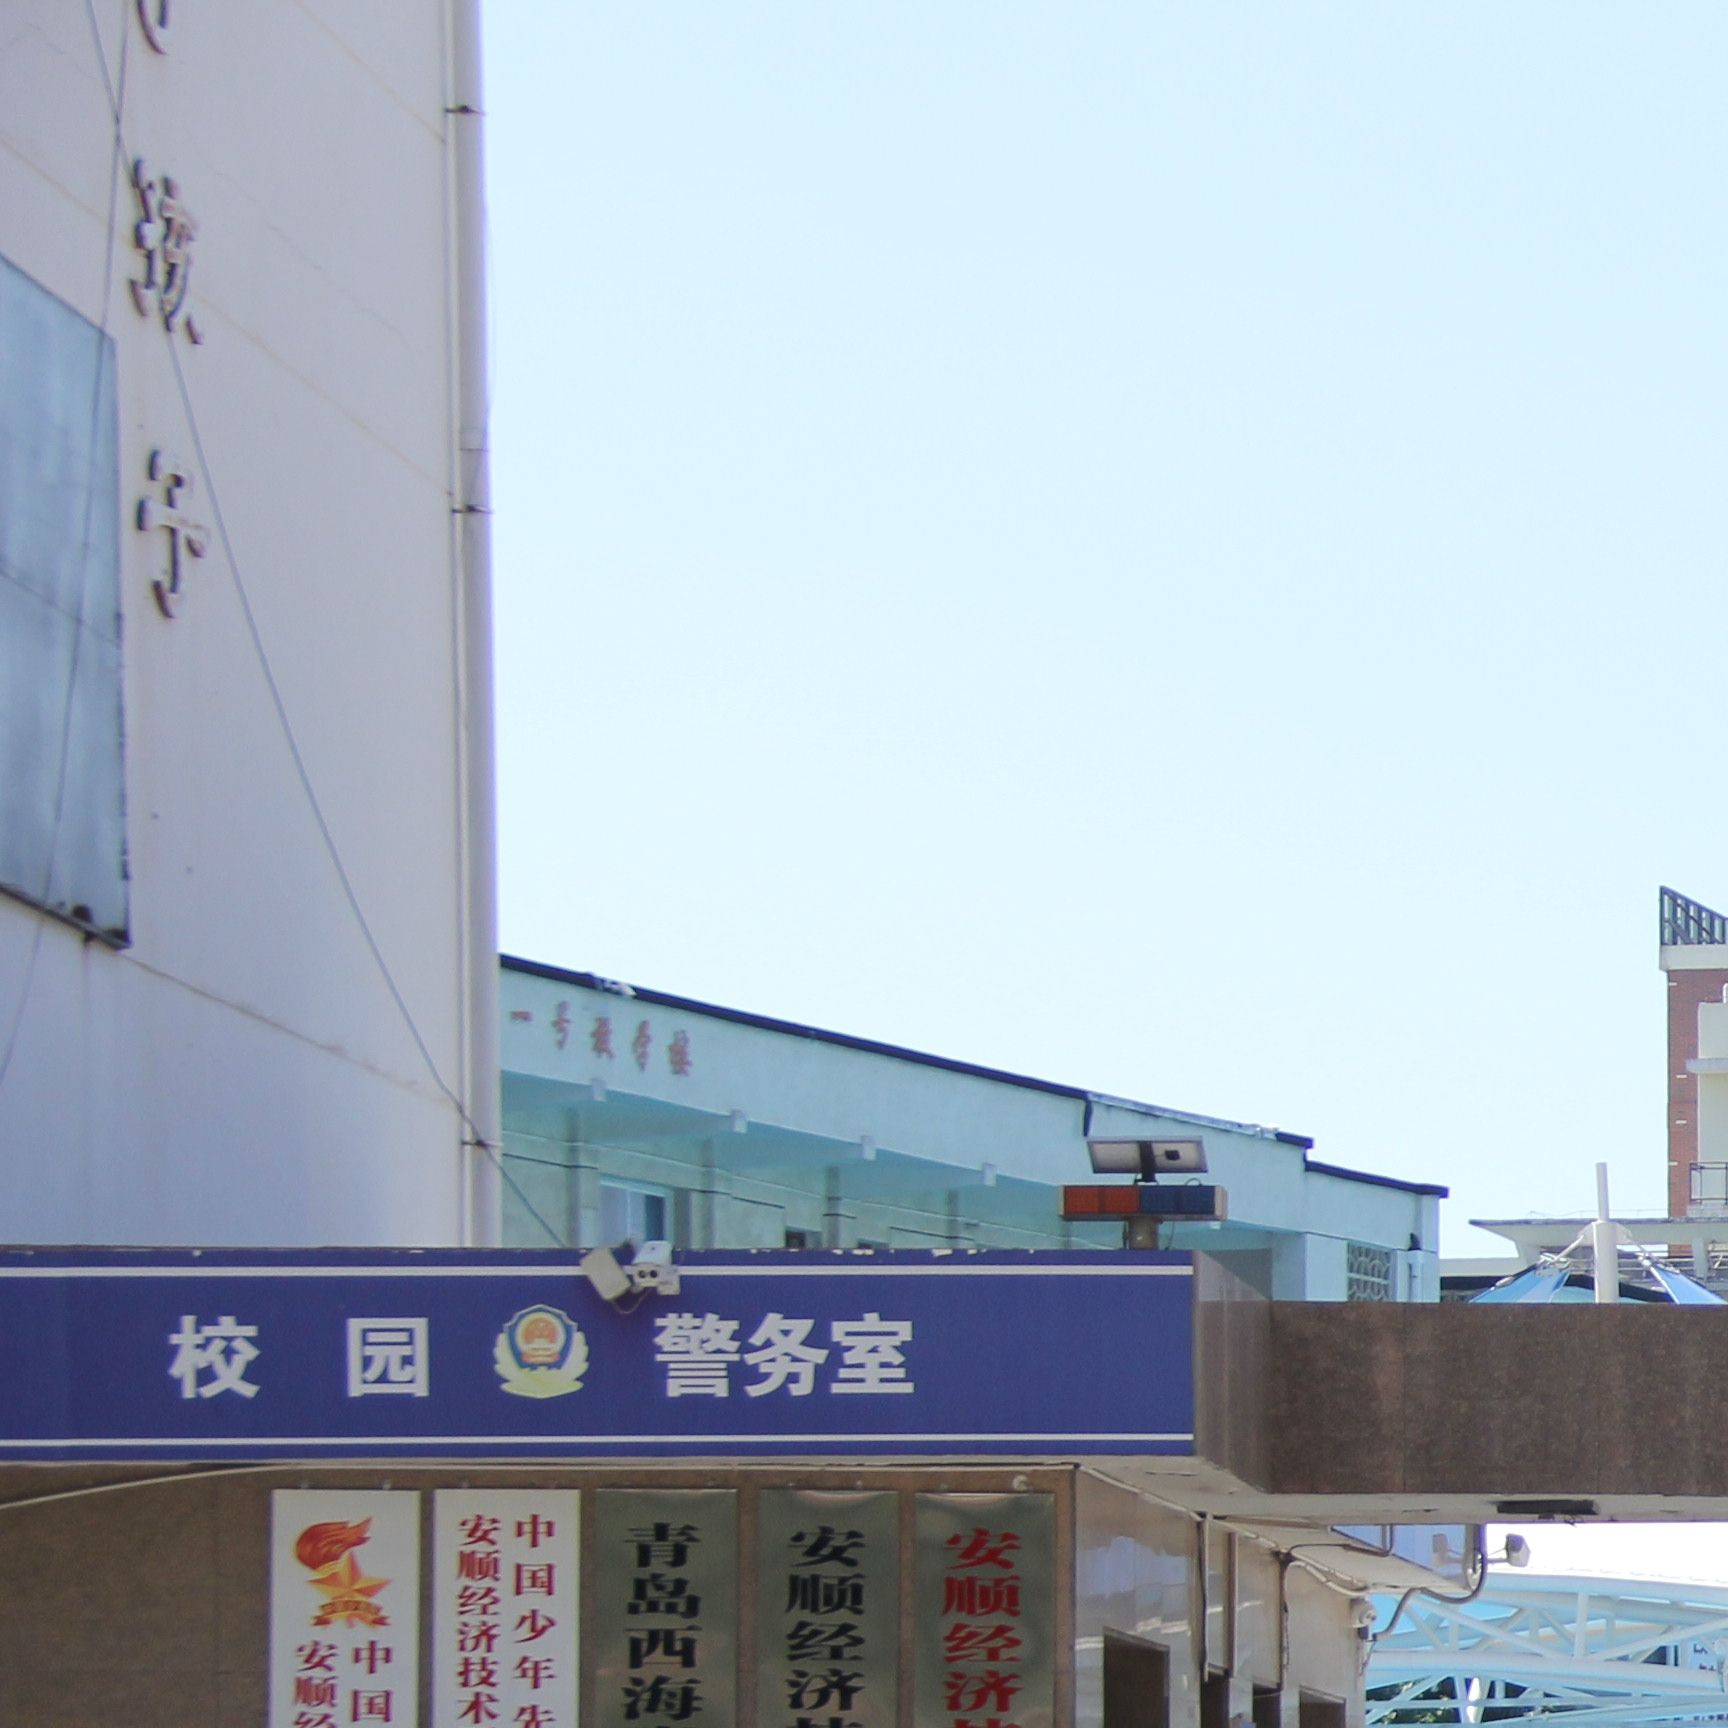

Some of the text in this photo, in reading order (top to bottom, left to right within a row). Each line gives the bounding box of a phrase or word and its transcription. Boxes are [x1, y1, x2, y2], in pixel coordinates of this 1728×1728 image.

[128, 0, 208, 620] 孩子
[168, 1312, 915, 1400] 校园 警务室
